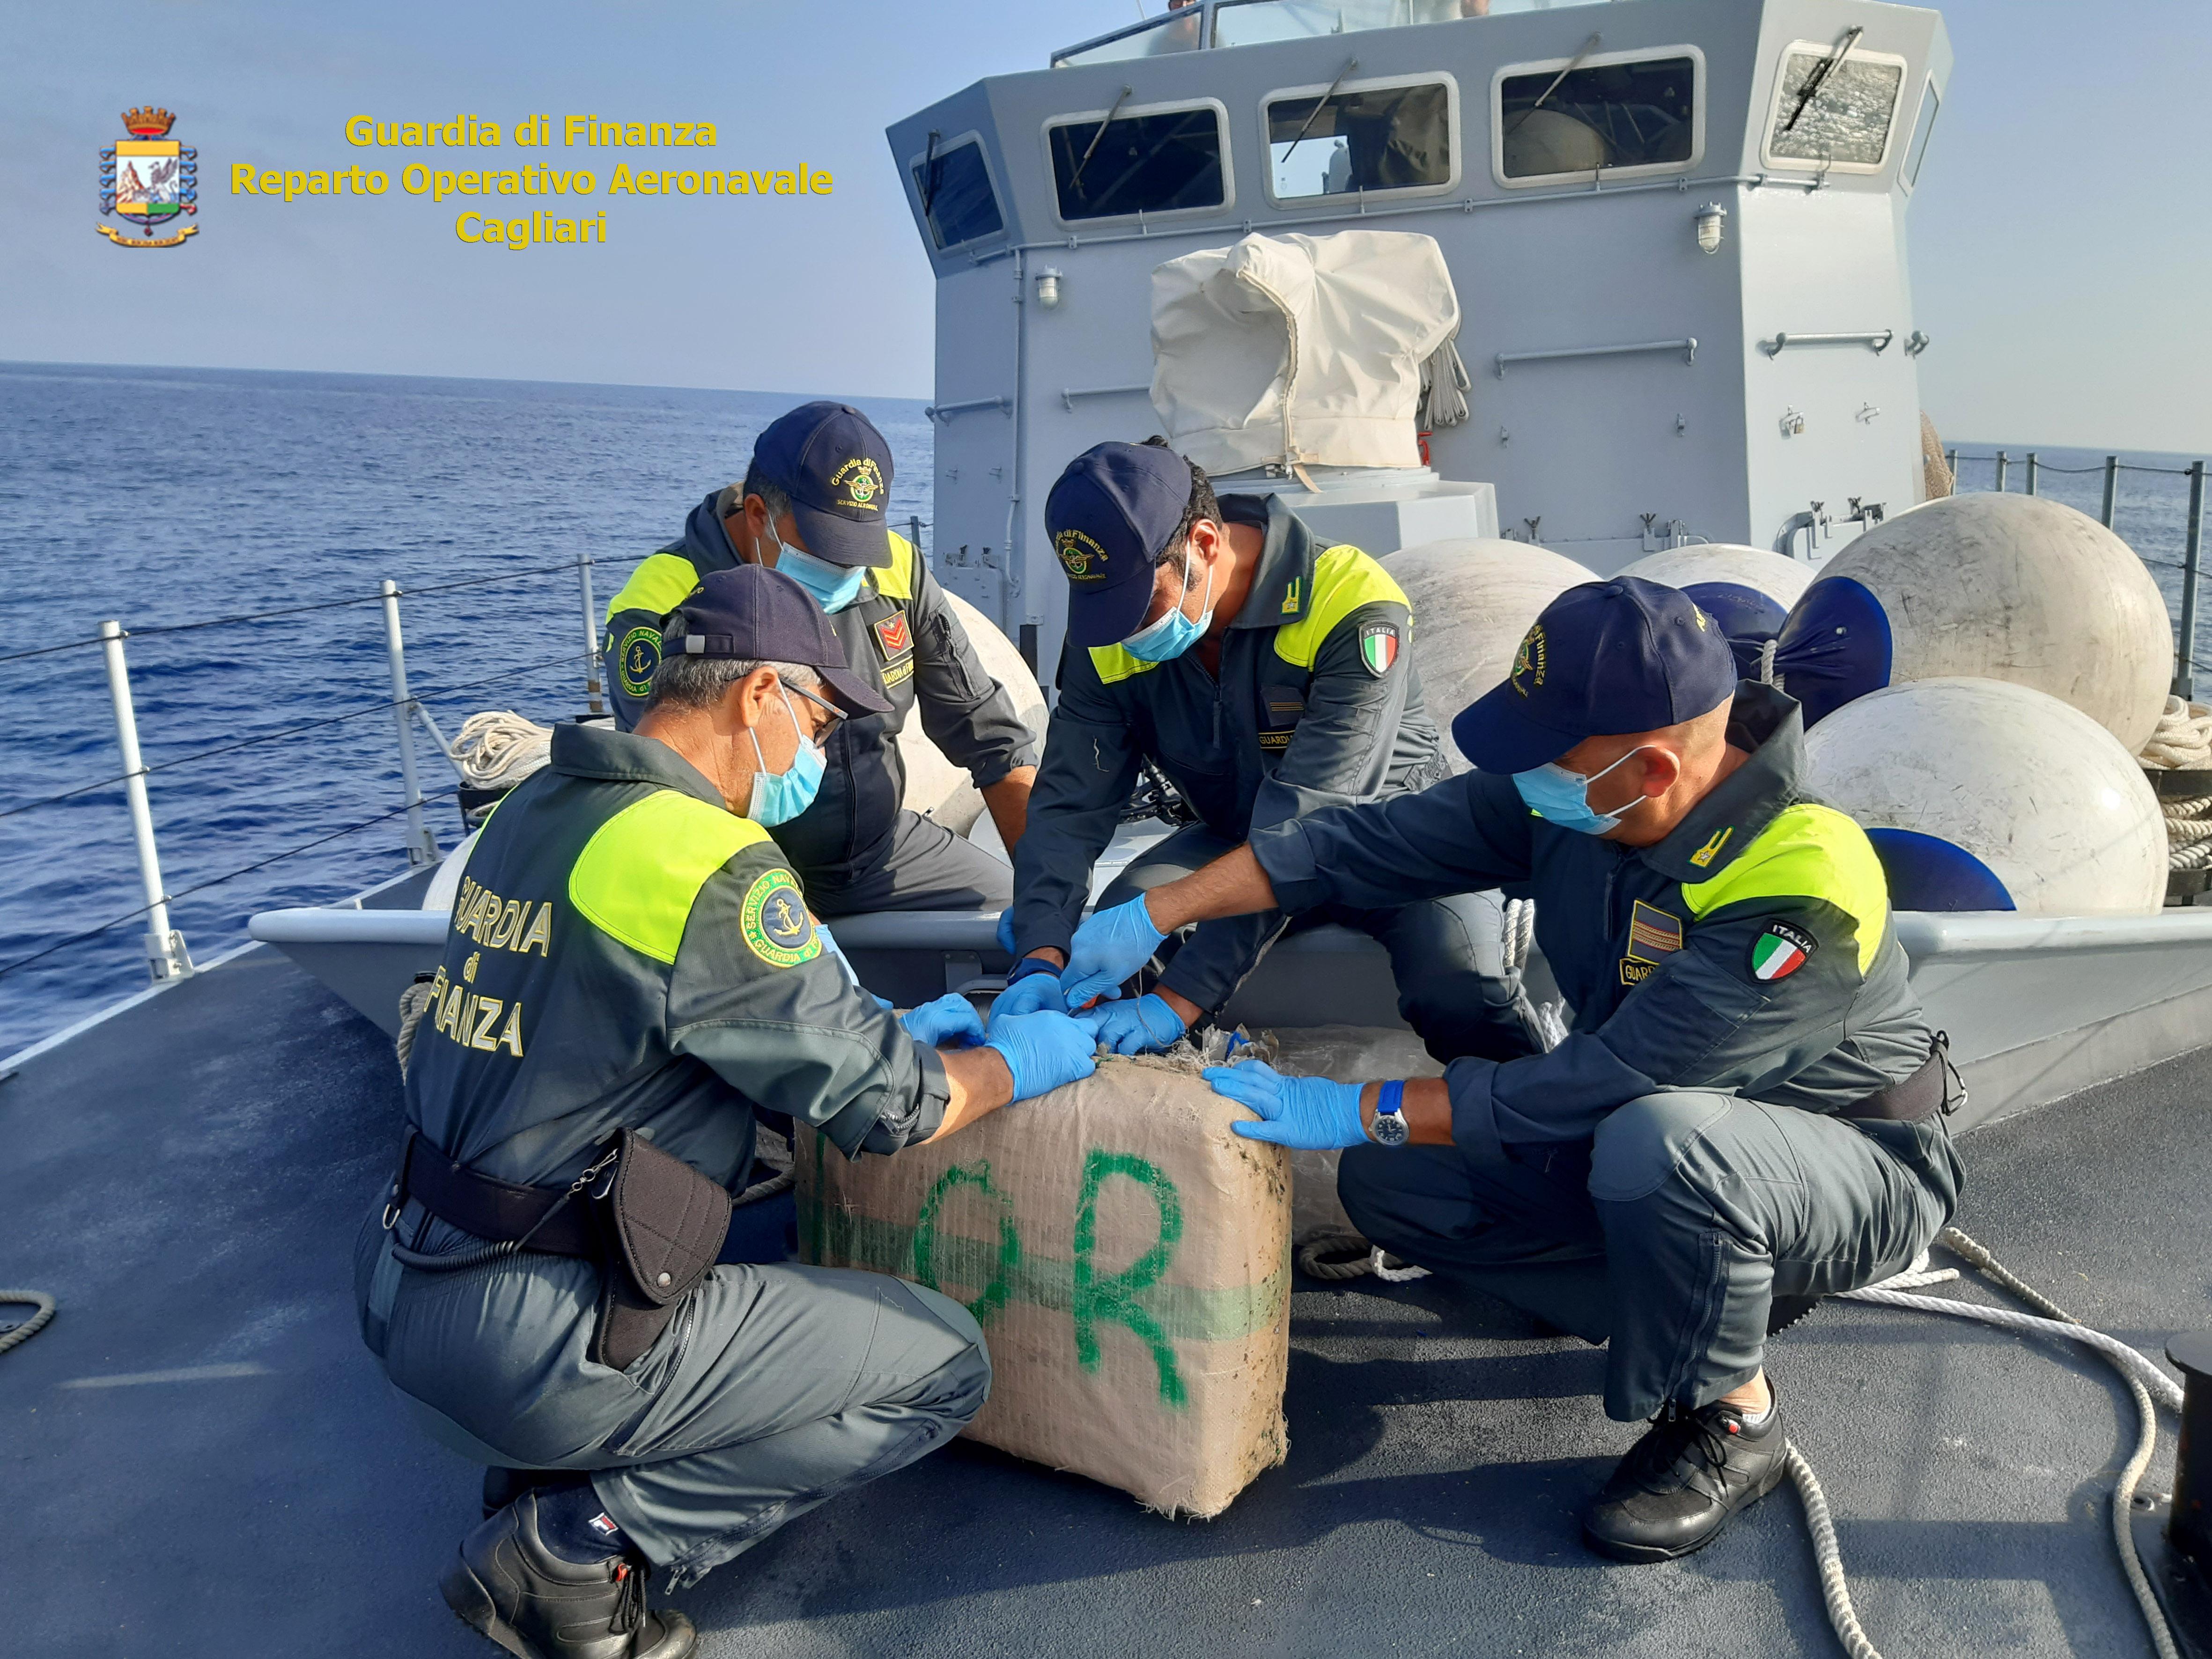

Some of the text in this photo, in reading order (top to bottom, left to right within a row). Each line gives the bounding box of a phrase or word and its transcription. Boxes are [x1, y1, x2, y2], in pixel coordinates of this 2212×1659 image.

[832, 458, 862, 486] Guardia
[870, 460, 884, 495] Finanza
[1073, 530, 1109, 561] Finanza
[1366, 627, 1394, 636] ITALIA
[454, 876, 552, 958] GUARDIA
[747, 881, 771, 929] SERVIZIO
[755, 939, 813, 962] GUARDIA di
[1773, 924, 1812, 953] ITALIA
[464, 951, 480, 984] di
